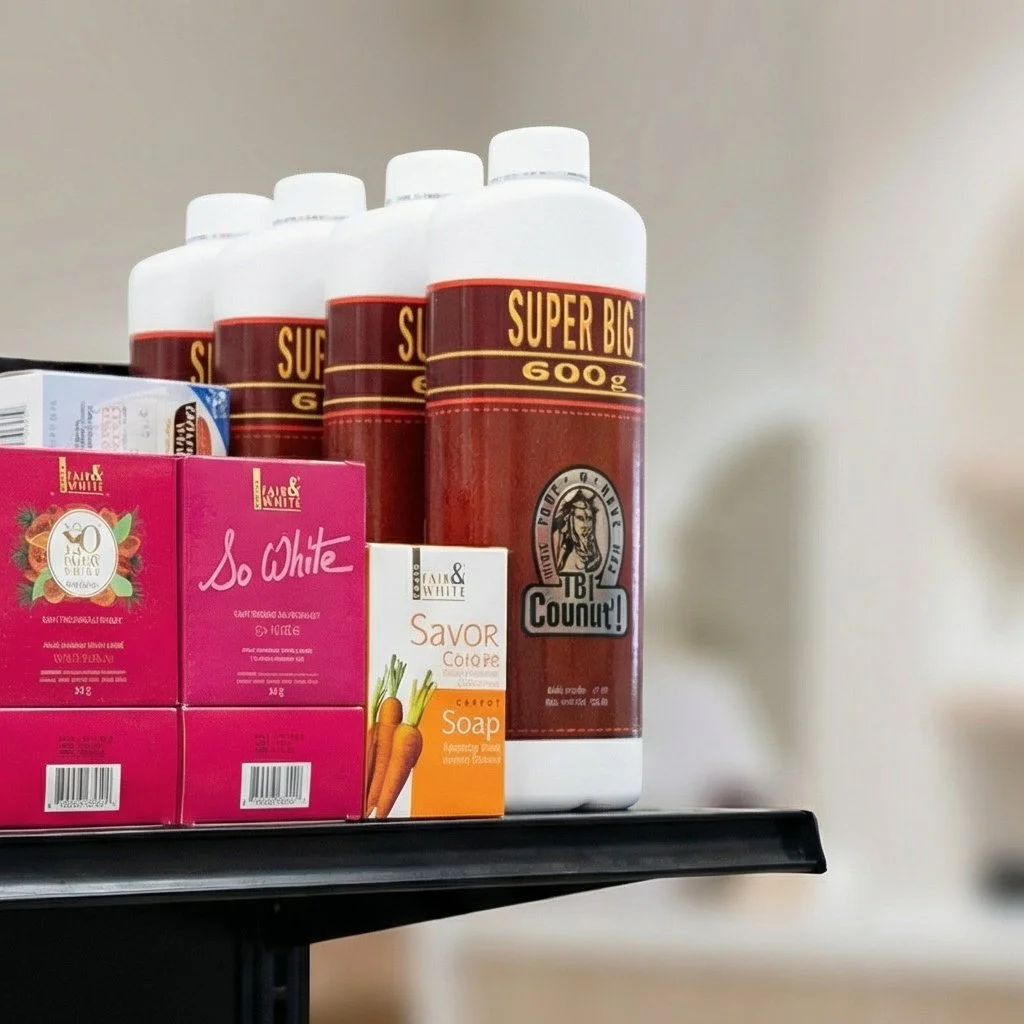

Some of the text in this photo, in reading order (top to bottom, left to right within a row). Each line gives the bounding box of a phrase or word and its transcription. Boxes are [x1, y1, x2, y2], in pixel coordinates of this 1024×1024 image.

[508, 288, 634, 358] SUPER BIG
[522, 360, 627, 392] 600g
[198, 526, 354, 592] So White
[441, 708, 501, 741] Soap
